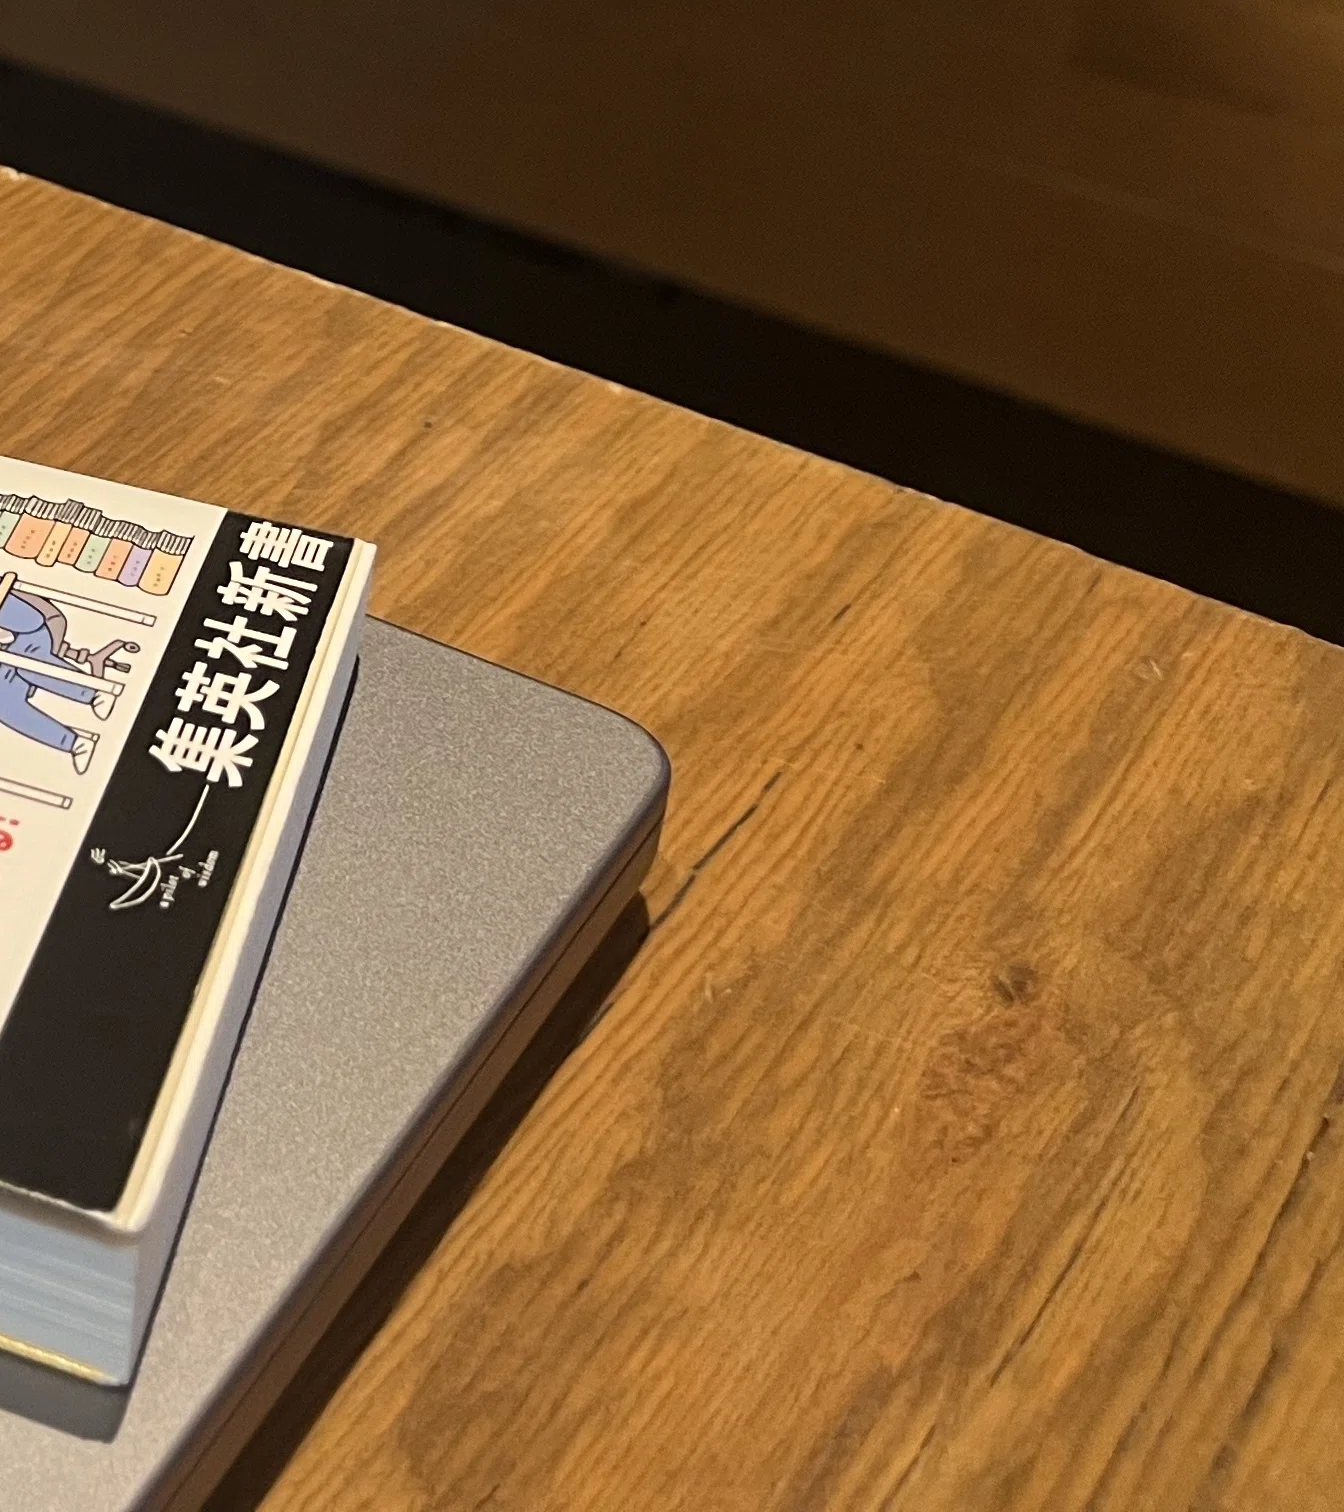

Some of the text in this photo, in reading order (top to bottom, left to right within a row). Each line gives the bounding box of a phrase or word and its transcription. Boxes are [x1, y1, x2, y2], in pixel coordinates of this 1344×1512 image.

[148, 519, 336, 789] 集英社新書
